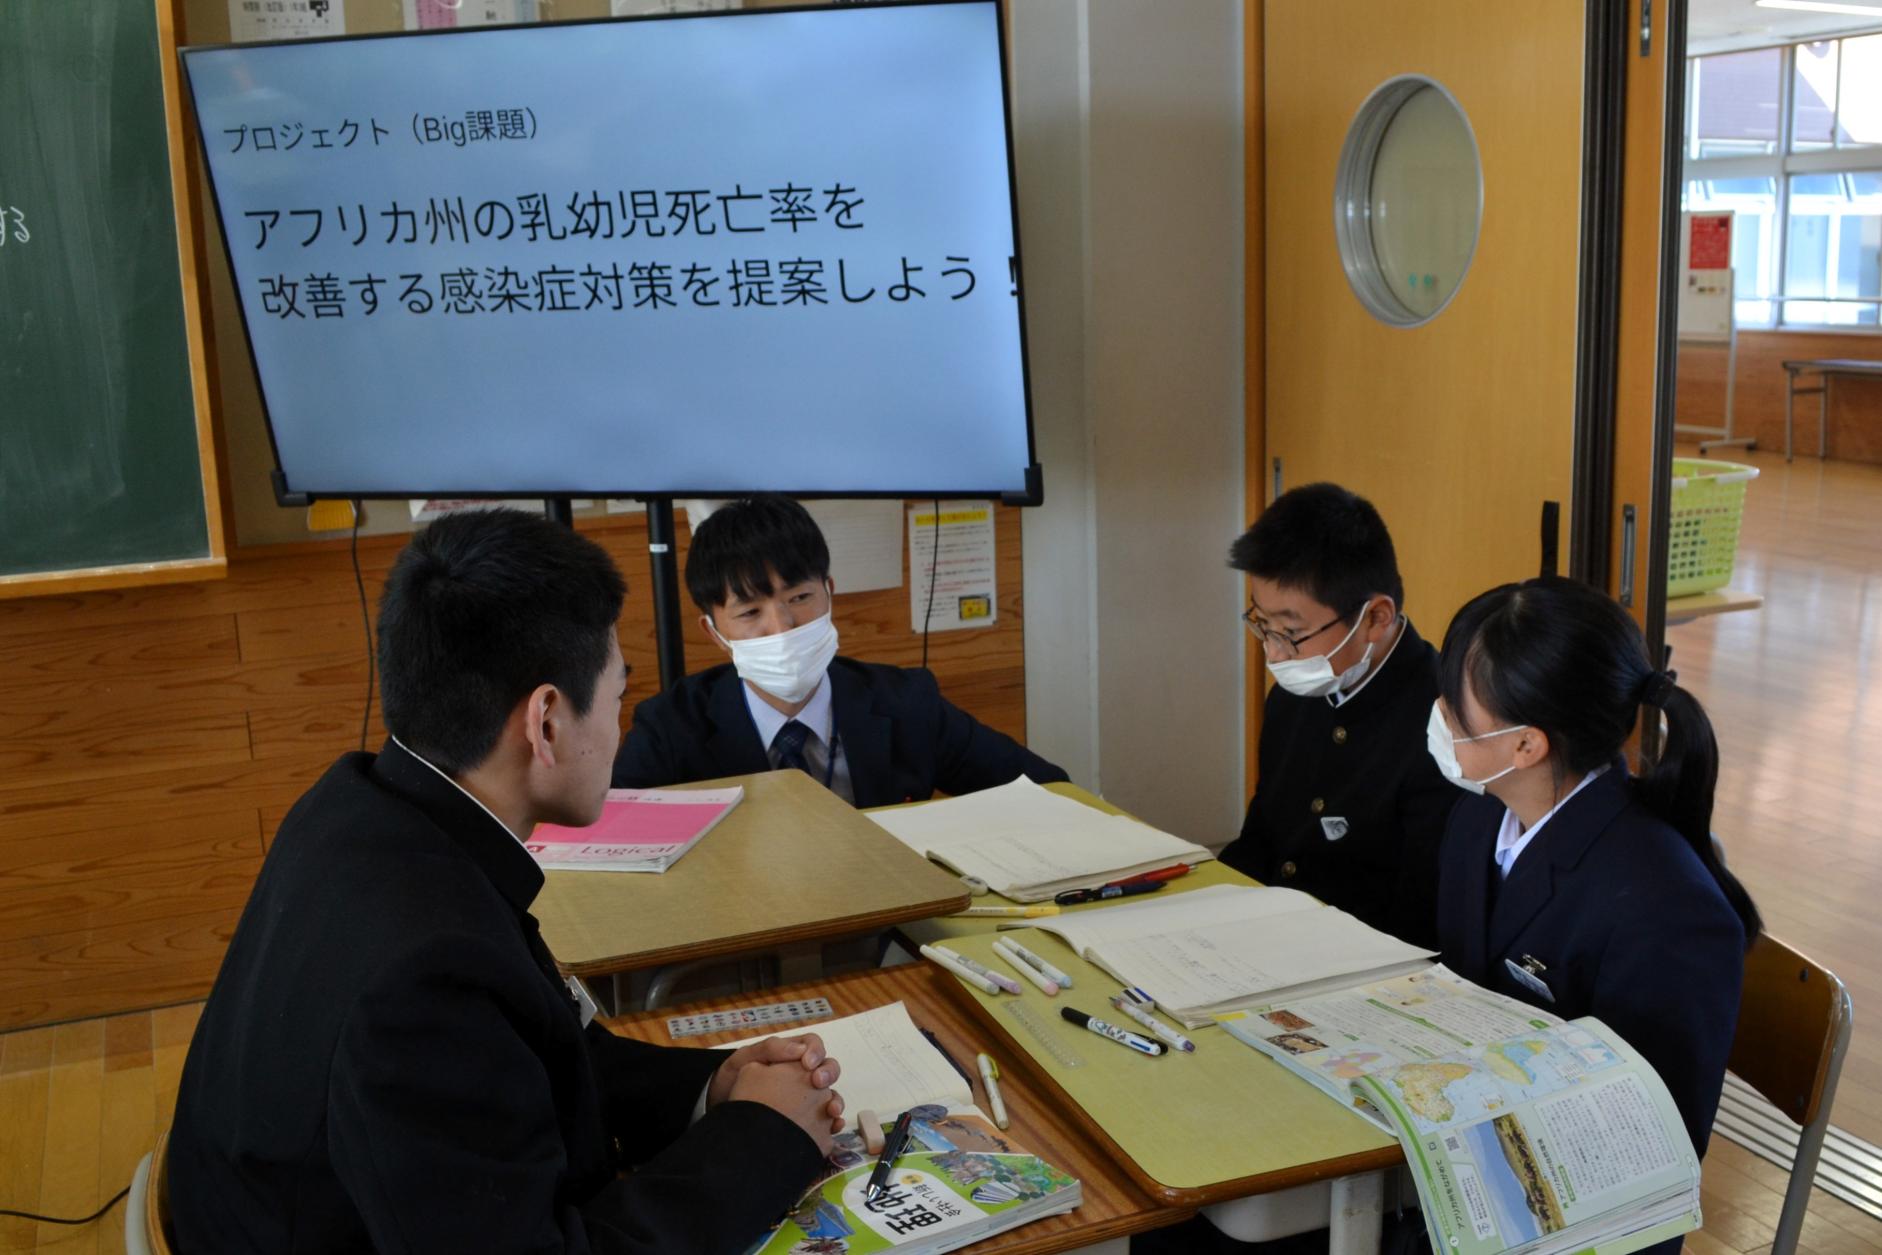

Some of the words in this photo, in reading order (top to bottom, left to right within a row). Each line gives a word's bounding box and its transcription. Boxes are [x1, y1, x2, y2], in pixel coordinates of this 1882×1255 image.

[244, 182, 865, 250] アフリカ州の乳幼児死亡率を
[580, 844, 676, 857] Logical
[912, 1184, 962, 1217] 新しい社会
